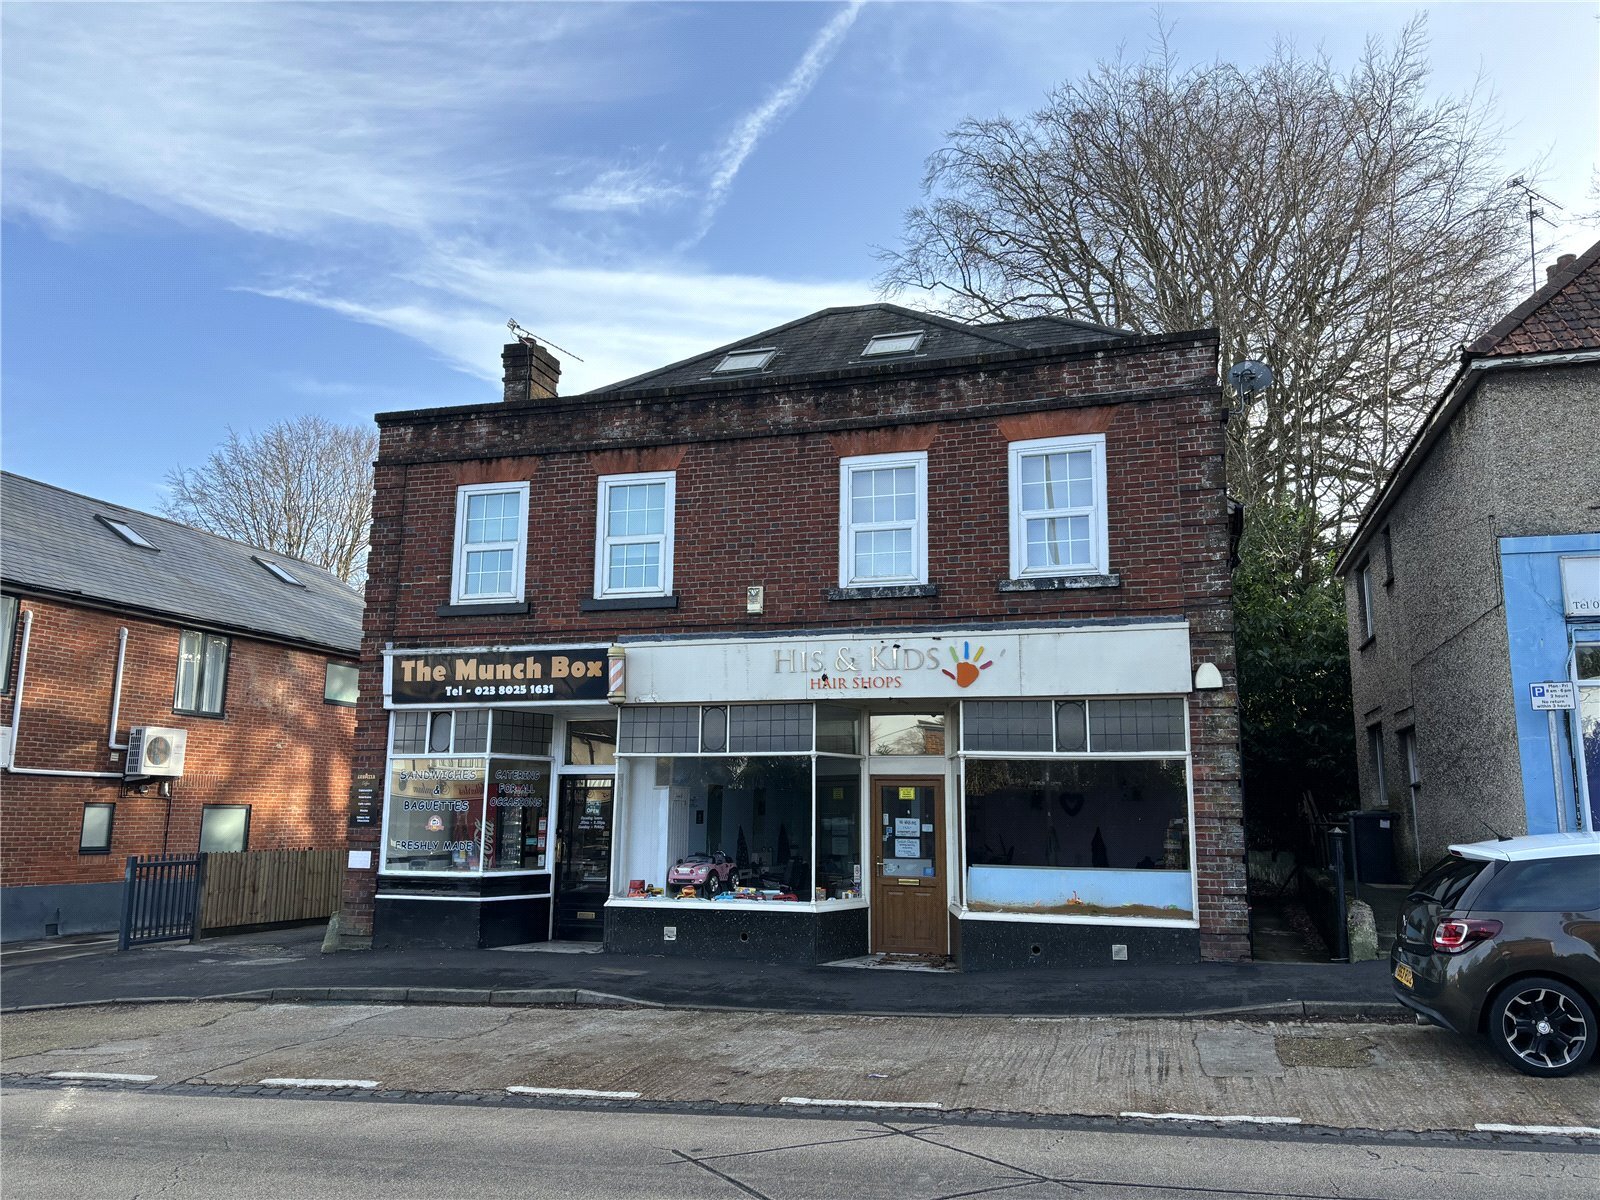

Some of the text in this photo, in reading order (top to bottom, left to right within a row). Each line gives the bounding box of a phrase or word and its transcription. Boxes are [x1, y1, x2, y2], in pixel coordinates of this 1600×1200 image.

[1572, 601, 1590, 609] Tel
[773, 645, 940, 673] HIS & KIDS
[401, 655, 603, 682] The Munch Box
[810, 676, 902, 690] HAIR SHOPS
[445, 685, 463, 697] Tel
[474, 685, 496, 696] 023
[498, 684, 527, 695] 8025
[530, 684, 554, 695] 1631
[1534, 687, 1543, 697] P
[400, 769, 477, 781] SANDWICHES
[495, 769, 540, 780] CATERING
[433, 784, 440, 795] &
[498, 783, 536, 794] FOR ALL
[403, 800, 470, 812] BAGUETTES
[489, 797, 542, 807] OCCASIONS
[395, 840, 473, 851] FRESHLY MADE
